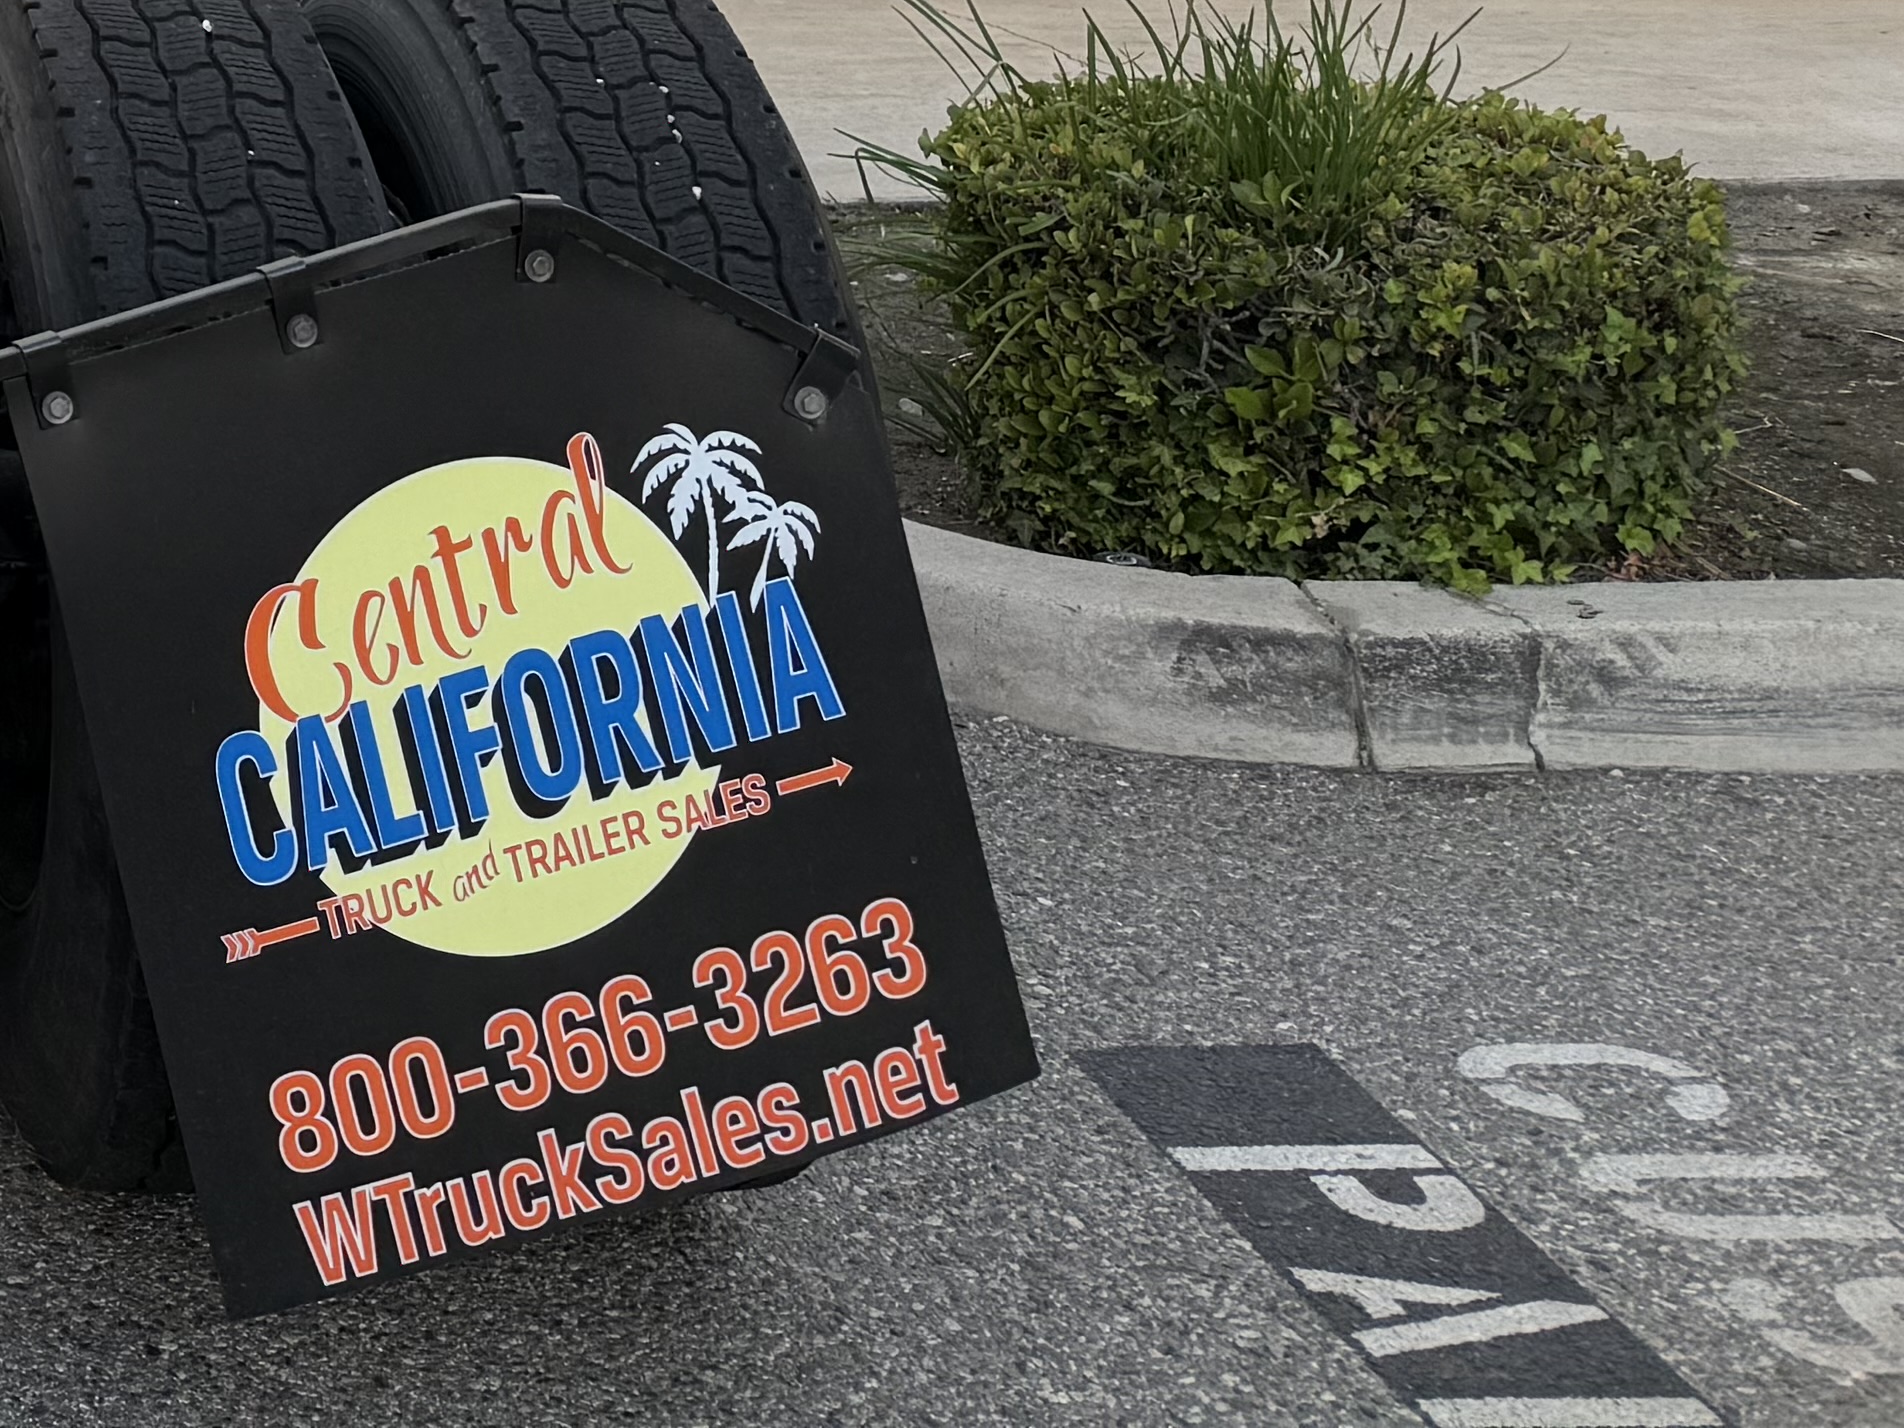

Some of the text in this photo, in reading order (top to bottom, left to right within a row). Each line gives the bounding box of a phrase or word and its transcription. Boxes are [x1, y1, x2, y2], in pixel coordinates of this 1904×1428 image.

[244, 432, 634, 724] Central
[214, 578, 847, 887] CALIFORNIA
[319, 775, 772, 941] TRUCK and TRAILER SALES
[268, 897, 928, 1174] 800-366-3263
[293, 1021, 960, 1287] WTruckSales.net
[1166, 1143, 1726, 1428] PA
